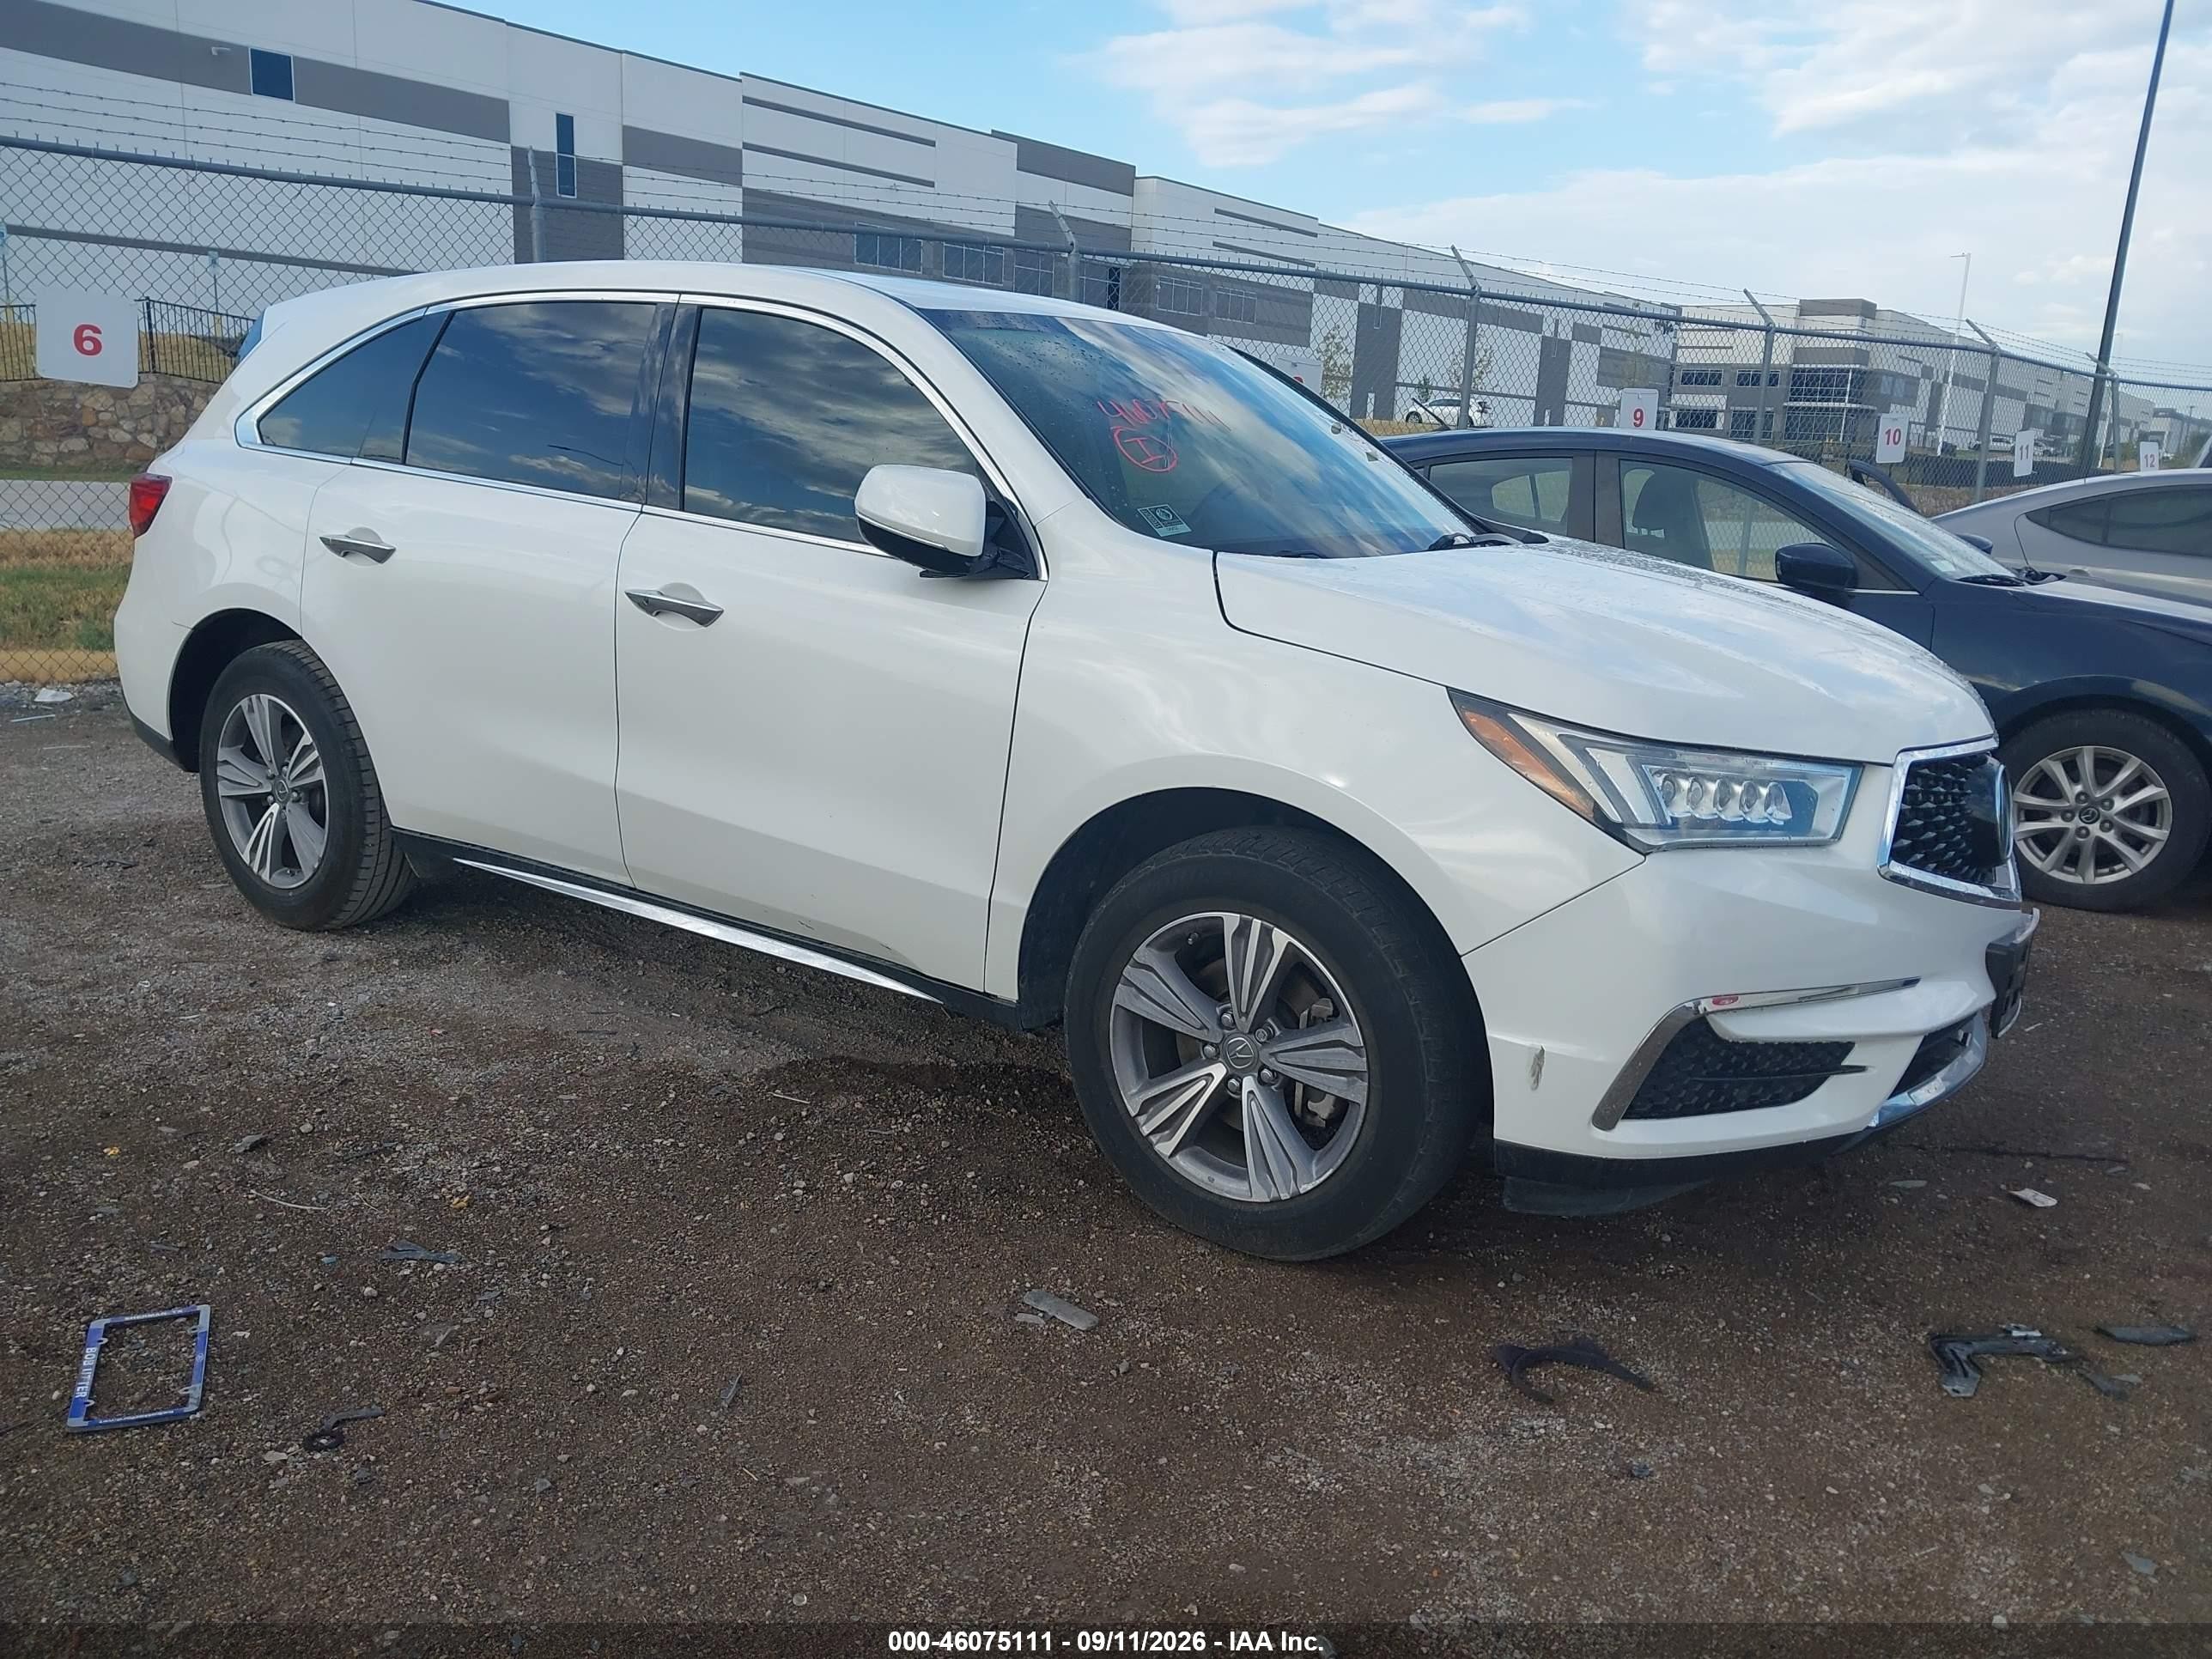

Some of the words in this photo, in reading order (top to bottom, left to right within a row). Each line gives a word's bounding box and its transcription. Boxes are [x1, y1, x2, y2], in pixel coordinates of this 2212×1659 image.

[72, 323, 103, 356] 6
[1633, 408, 1644, 428] 9
[1885, 428, 1902, 446] 10
[2020, 444, 2030, 461] 11
[2143, 453, 2156, 468] 12
[83, 1346, 97, 1365] BOB
